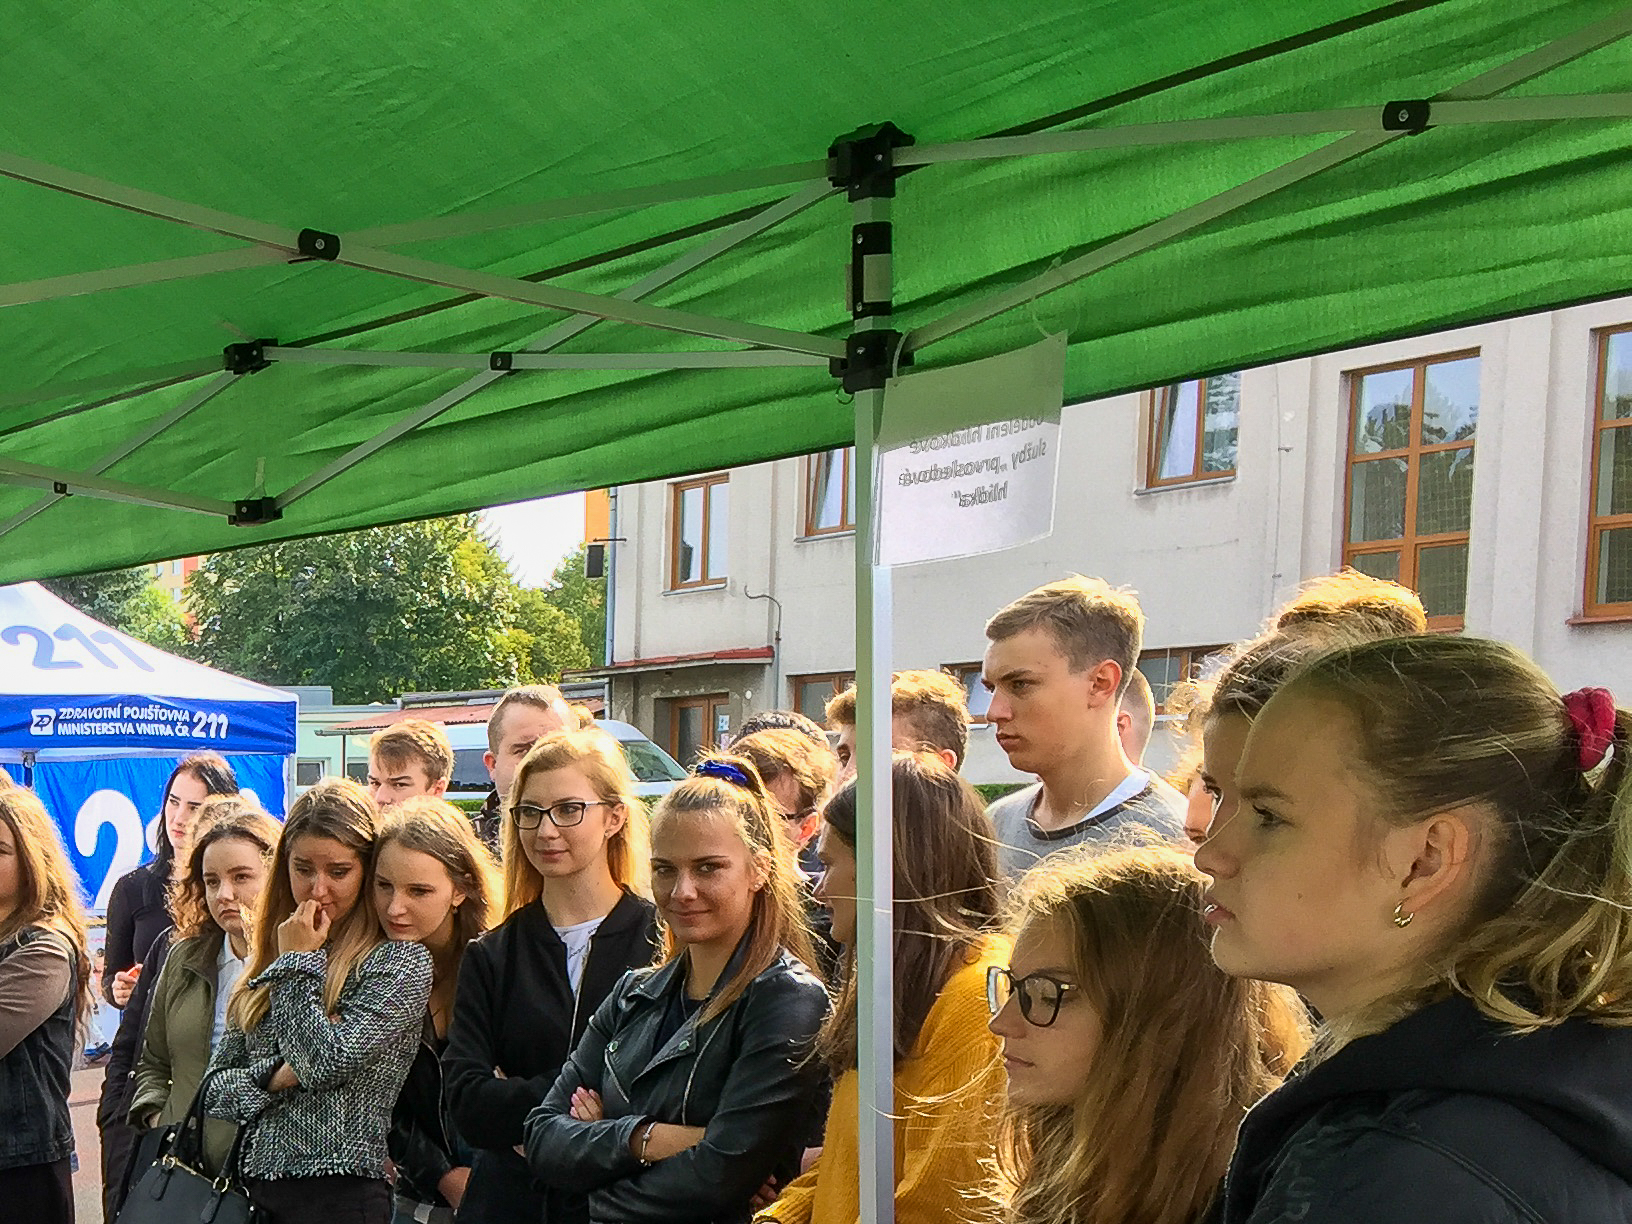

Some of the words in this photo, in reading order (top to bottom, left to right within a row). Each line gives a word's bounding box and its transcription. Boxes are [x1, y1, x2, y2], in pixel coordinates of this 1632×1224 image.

[0, 623, 155, 672] 211
[58, 703, 122, 720] ZDRAVOTNÍ
[124, 704, 190, 722] POJIŠŤOVNA
[57, 722, 135, 736] MINISTERSTVA
[136, 722, 174, 737] VNITRA
[175, 721, 190, 737] ČR
[191, 711, 229, 739] 211
